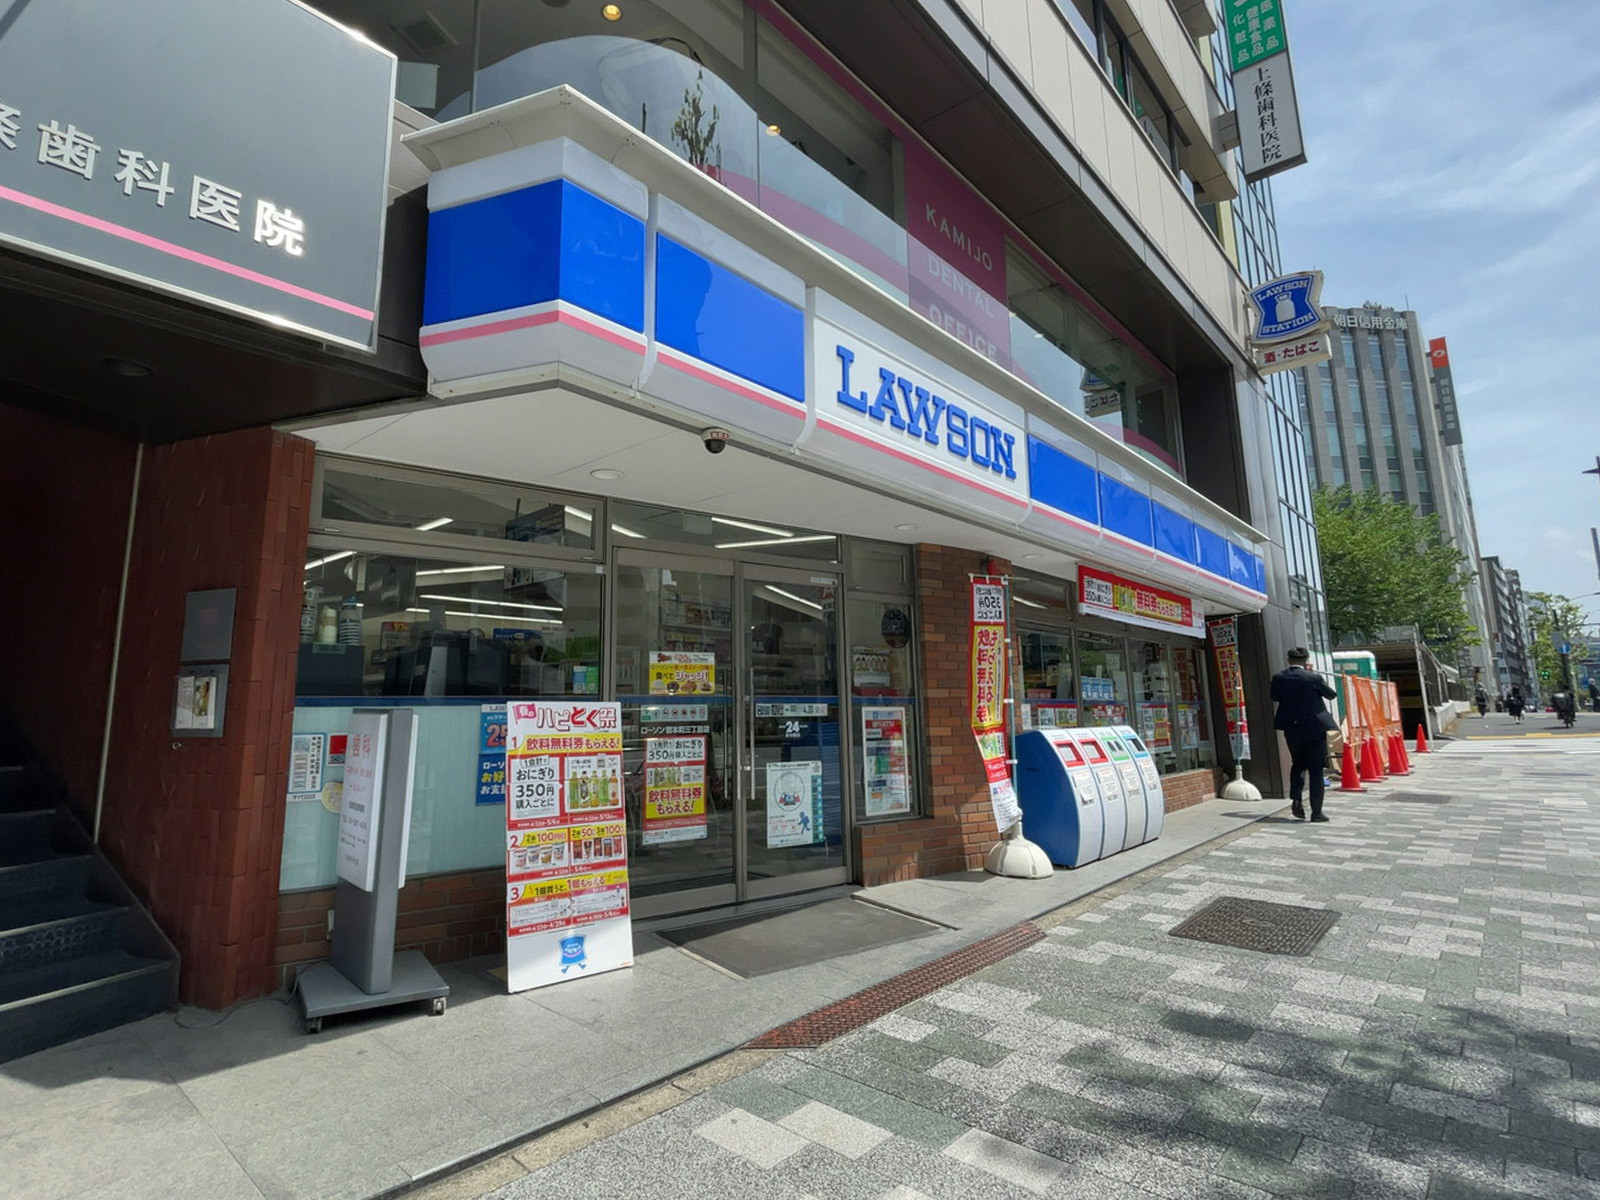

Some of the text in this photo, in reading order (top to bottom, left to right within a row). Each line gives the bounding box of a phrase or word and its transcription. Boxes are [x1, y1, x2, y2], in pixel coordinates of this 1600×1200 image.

[1233, 14, 1250, 63] 化粧品
[1246, 6, 1265, 57] 健康食品
[1254, 67, 1282, 164] 上條歯科医院
[926, 203, 993, 272] KAMIJO
[928, 254, 994, 317] DENTAL
[1257, 280, 1309, 301] LAWSON
[929, 304, 997, 360] OFFICE
[1262, 312, 1315, 334] STATION
[836, 344, 1016, 480] LAWSON
[640, 726, 665, 734] ローソン
[516, 767, 555, 780] おにぎり
